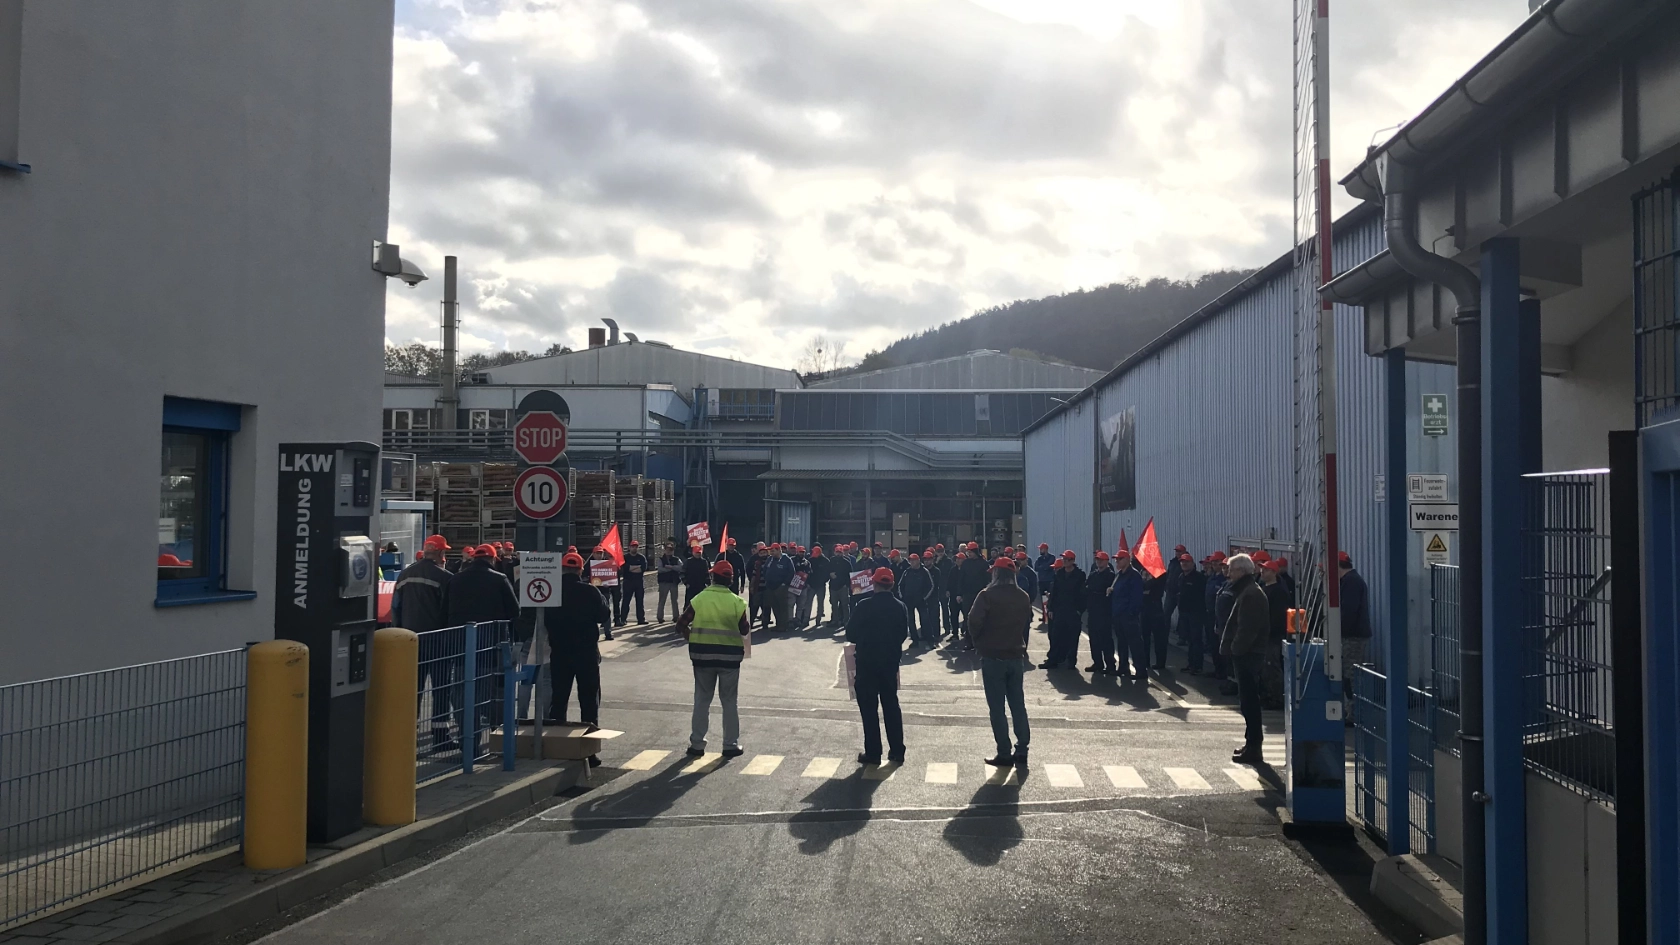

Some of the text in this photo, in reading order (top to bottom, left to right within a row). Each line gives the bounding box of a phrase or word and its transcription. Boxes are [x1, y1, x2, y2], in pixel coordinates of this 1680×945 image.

[519, 427, 562, 448] STOP
[280, 453, 333, 473] LKW
[527, 481, 553, 505] 10
[293, 478, 312, 609] ANMELDUNG
